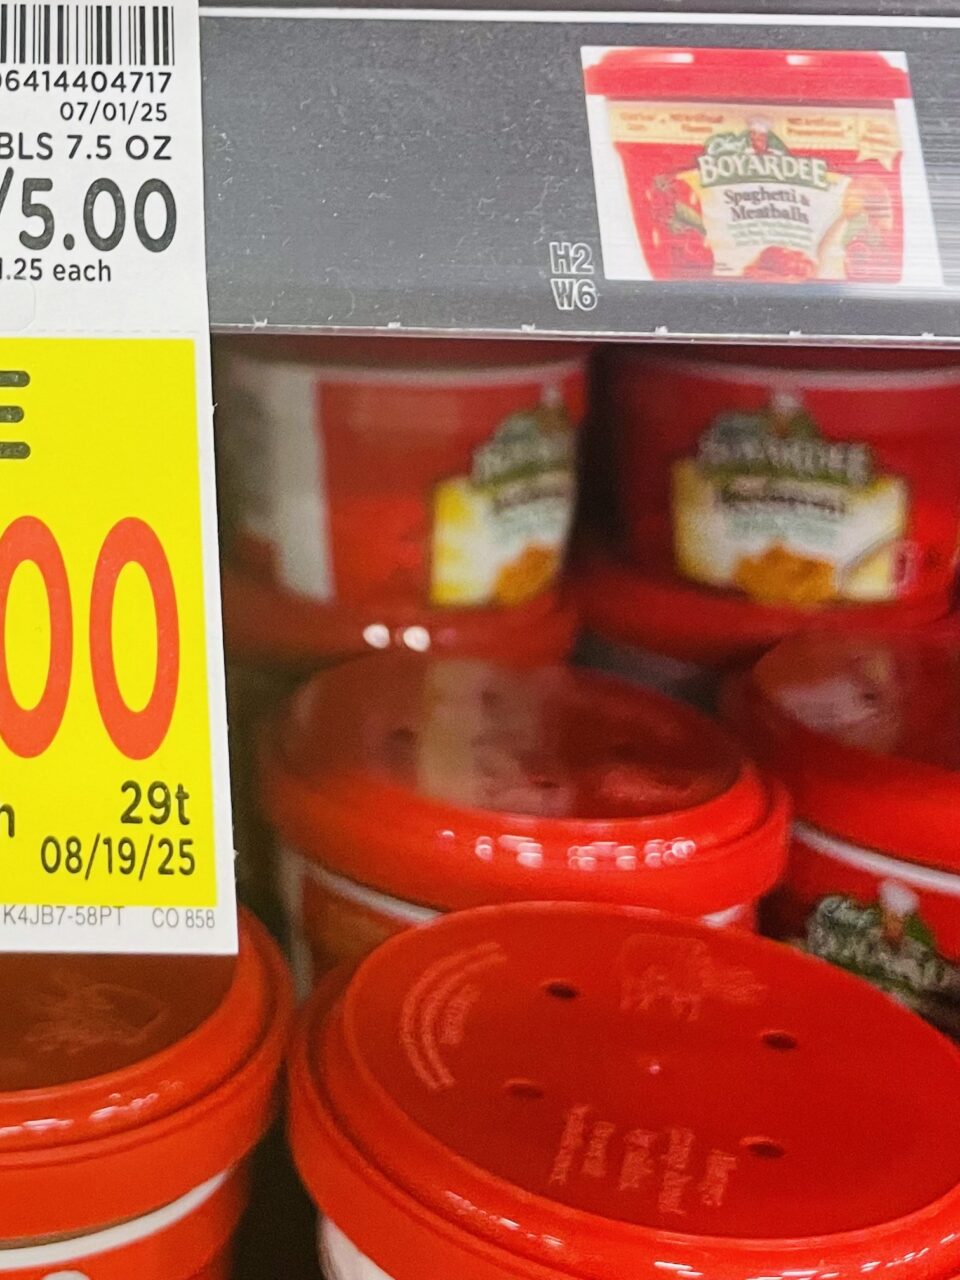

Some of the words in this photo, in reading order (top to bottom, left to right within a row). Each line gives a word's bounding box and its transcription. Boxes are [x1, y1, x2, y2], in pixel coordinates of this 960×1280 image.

[59, 101, 167, 124] 07/01/25
[66, 134, 112, 160] 7.5
[125, 135, 172, 161] OZ
[698, 155, 828, 187] BOYARDEE
[52, 259, 112, 282] each
[549, 241, 594, 275] H2
[551, 279, 599, 311] W6
[120, 779, 191, 826] 29t
[40, 833, 196, 882] 08/19/25
[152, 907, 179, 928] CO
[185, 908, 215, 929] 858
